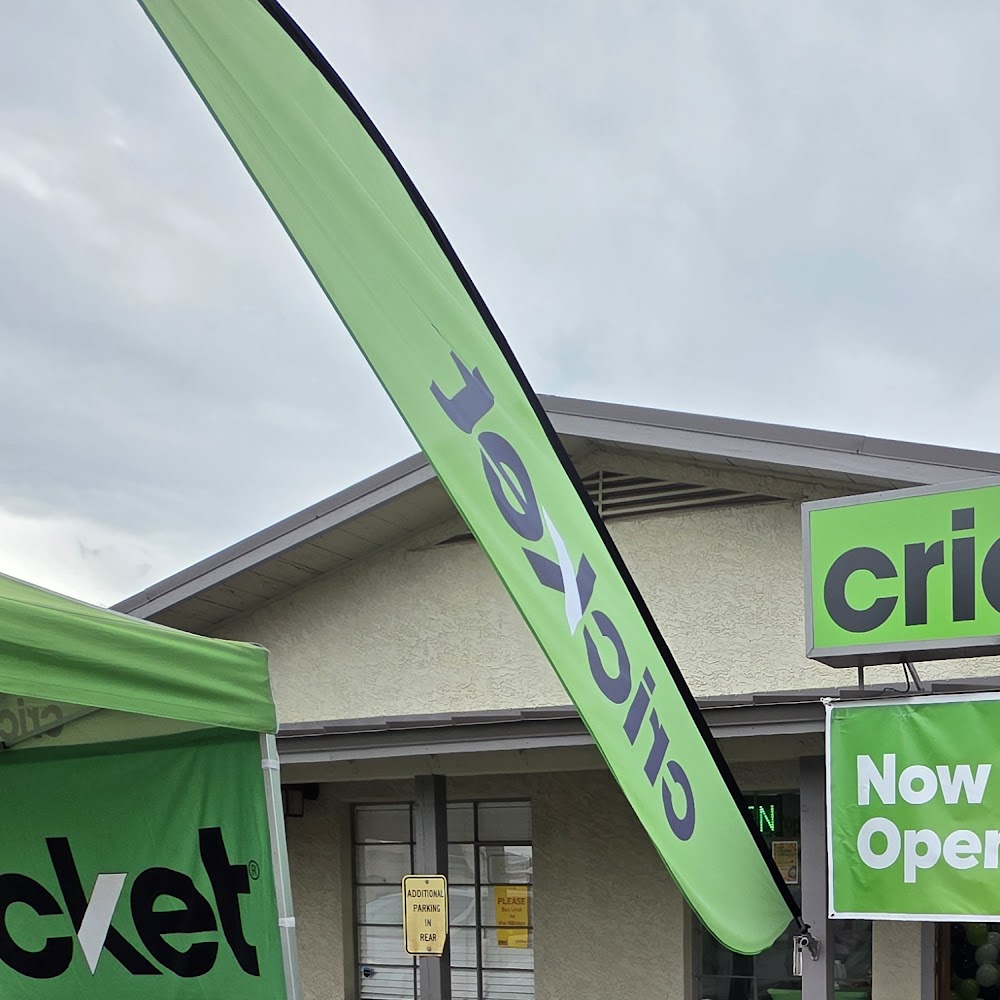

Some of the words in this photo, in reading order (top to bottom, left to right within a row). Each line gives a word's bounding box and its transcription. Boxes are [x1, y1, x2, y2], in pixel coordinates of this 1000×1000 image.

[857, 753, 992, 806] Now
[407, 889, 444, 898] ADDITIONAL
[497, 897, 526, 905] PLEASE
[413, 904, 441, 913] PARKING
[425, 919, 431, 927] IN
[420, 933, 437, 942] REAR
